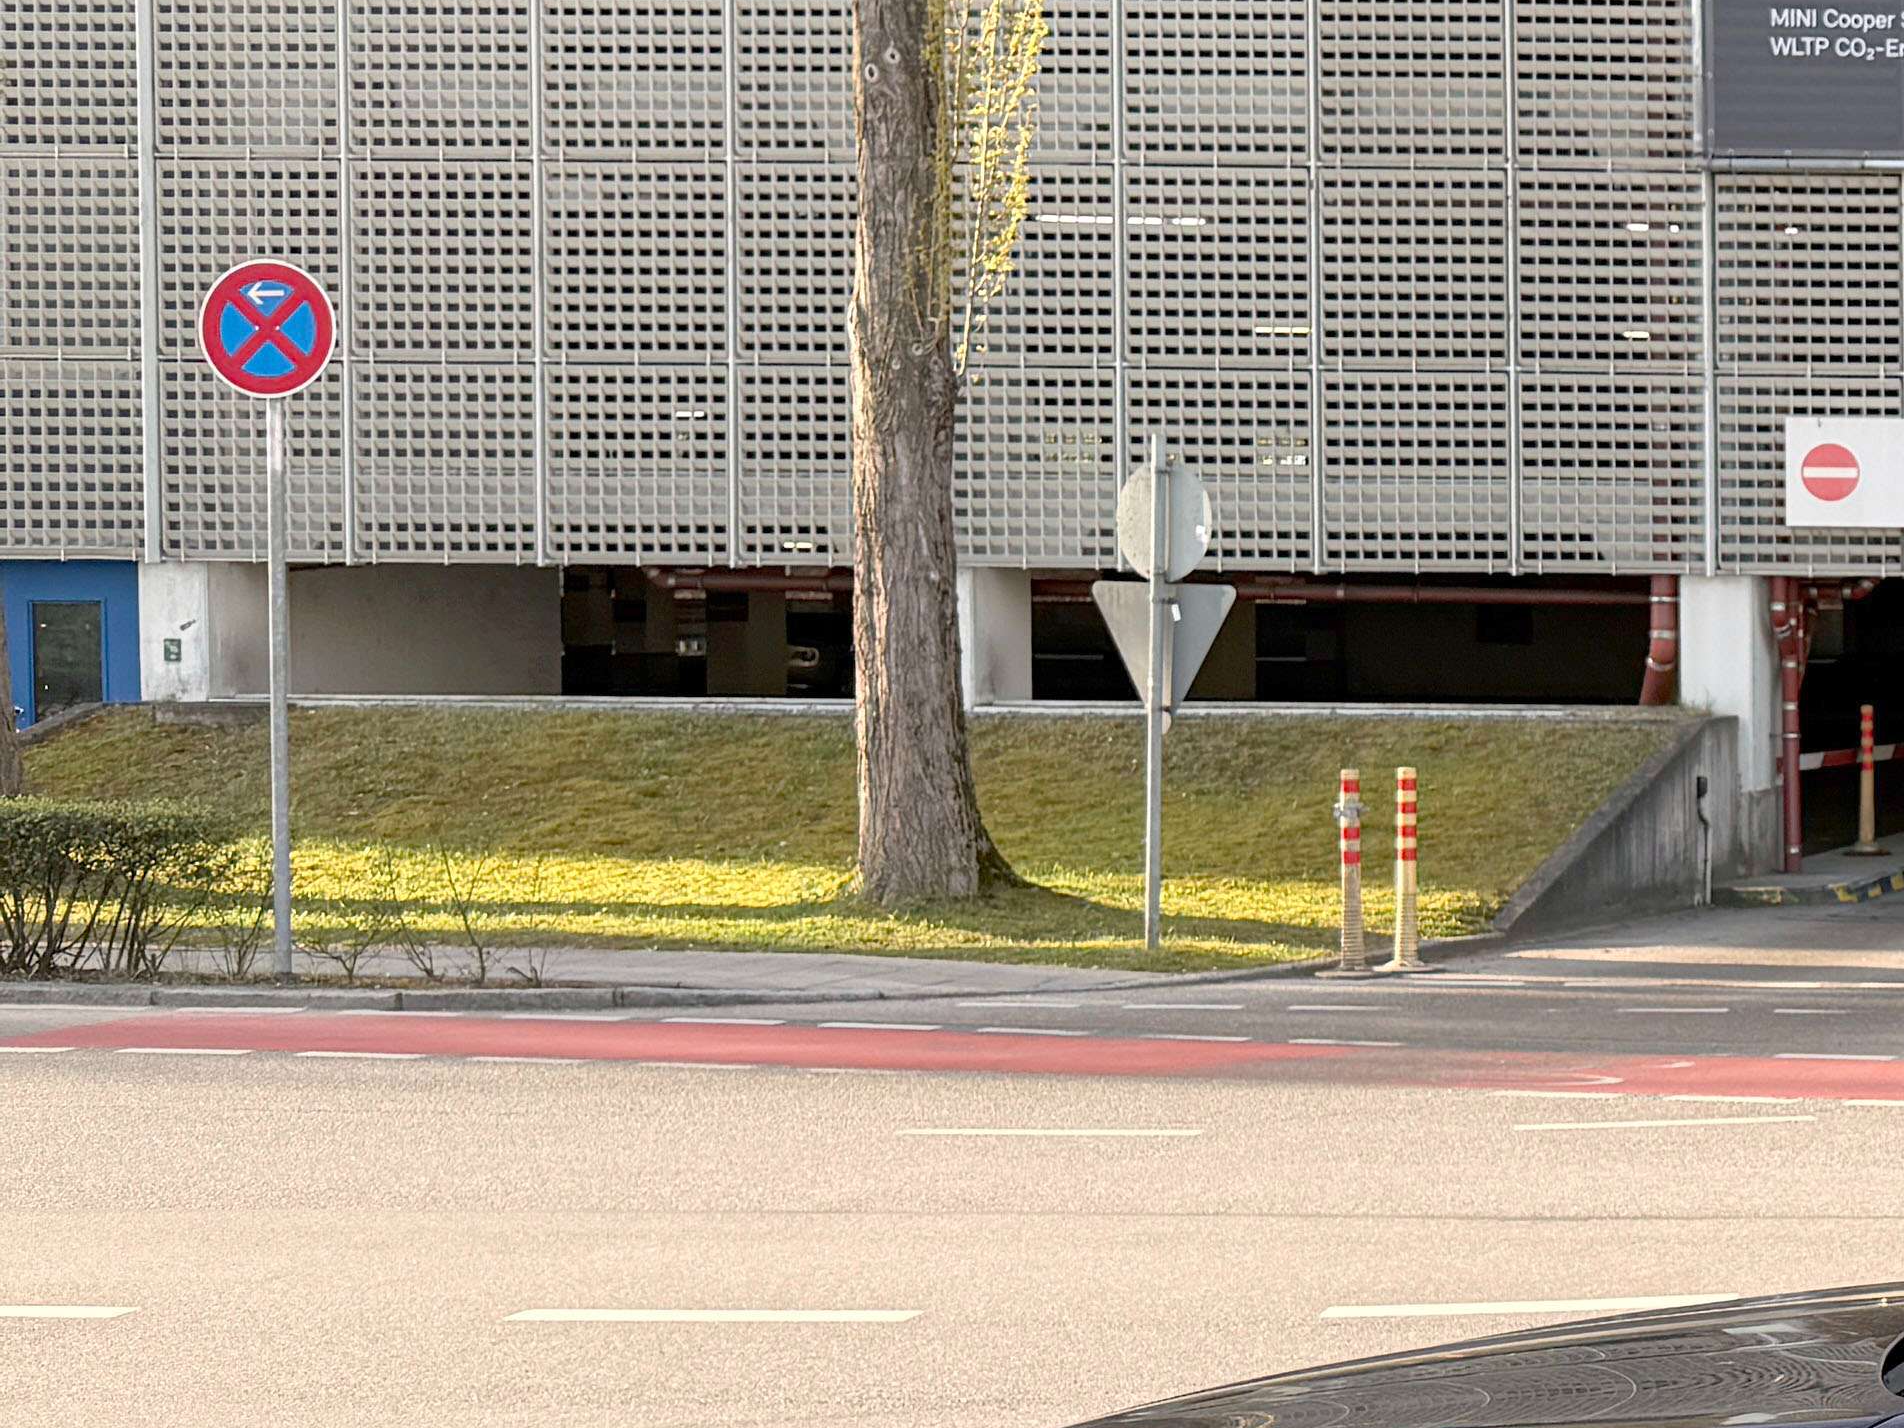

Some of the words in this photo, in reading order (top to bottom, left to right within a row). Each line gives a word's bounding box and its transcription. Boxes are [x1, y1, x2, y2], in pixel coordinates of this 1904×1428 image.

[1771, 9, 1816, 27] MINI
[1823, 9, 1895, 33] Cooper
[1770, 37, 1829, 55] WLTP
